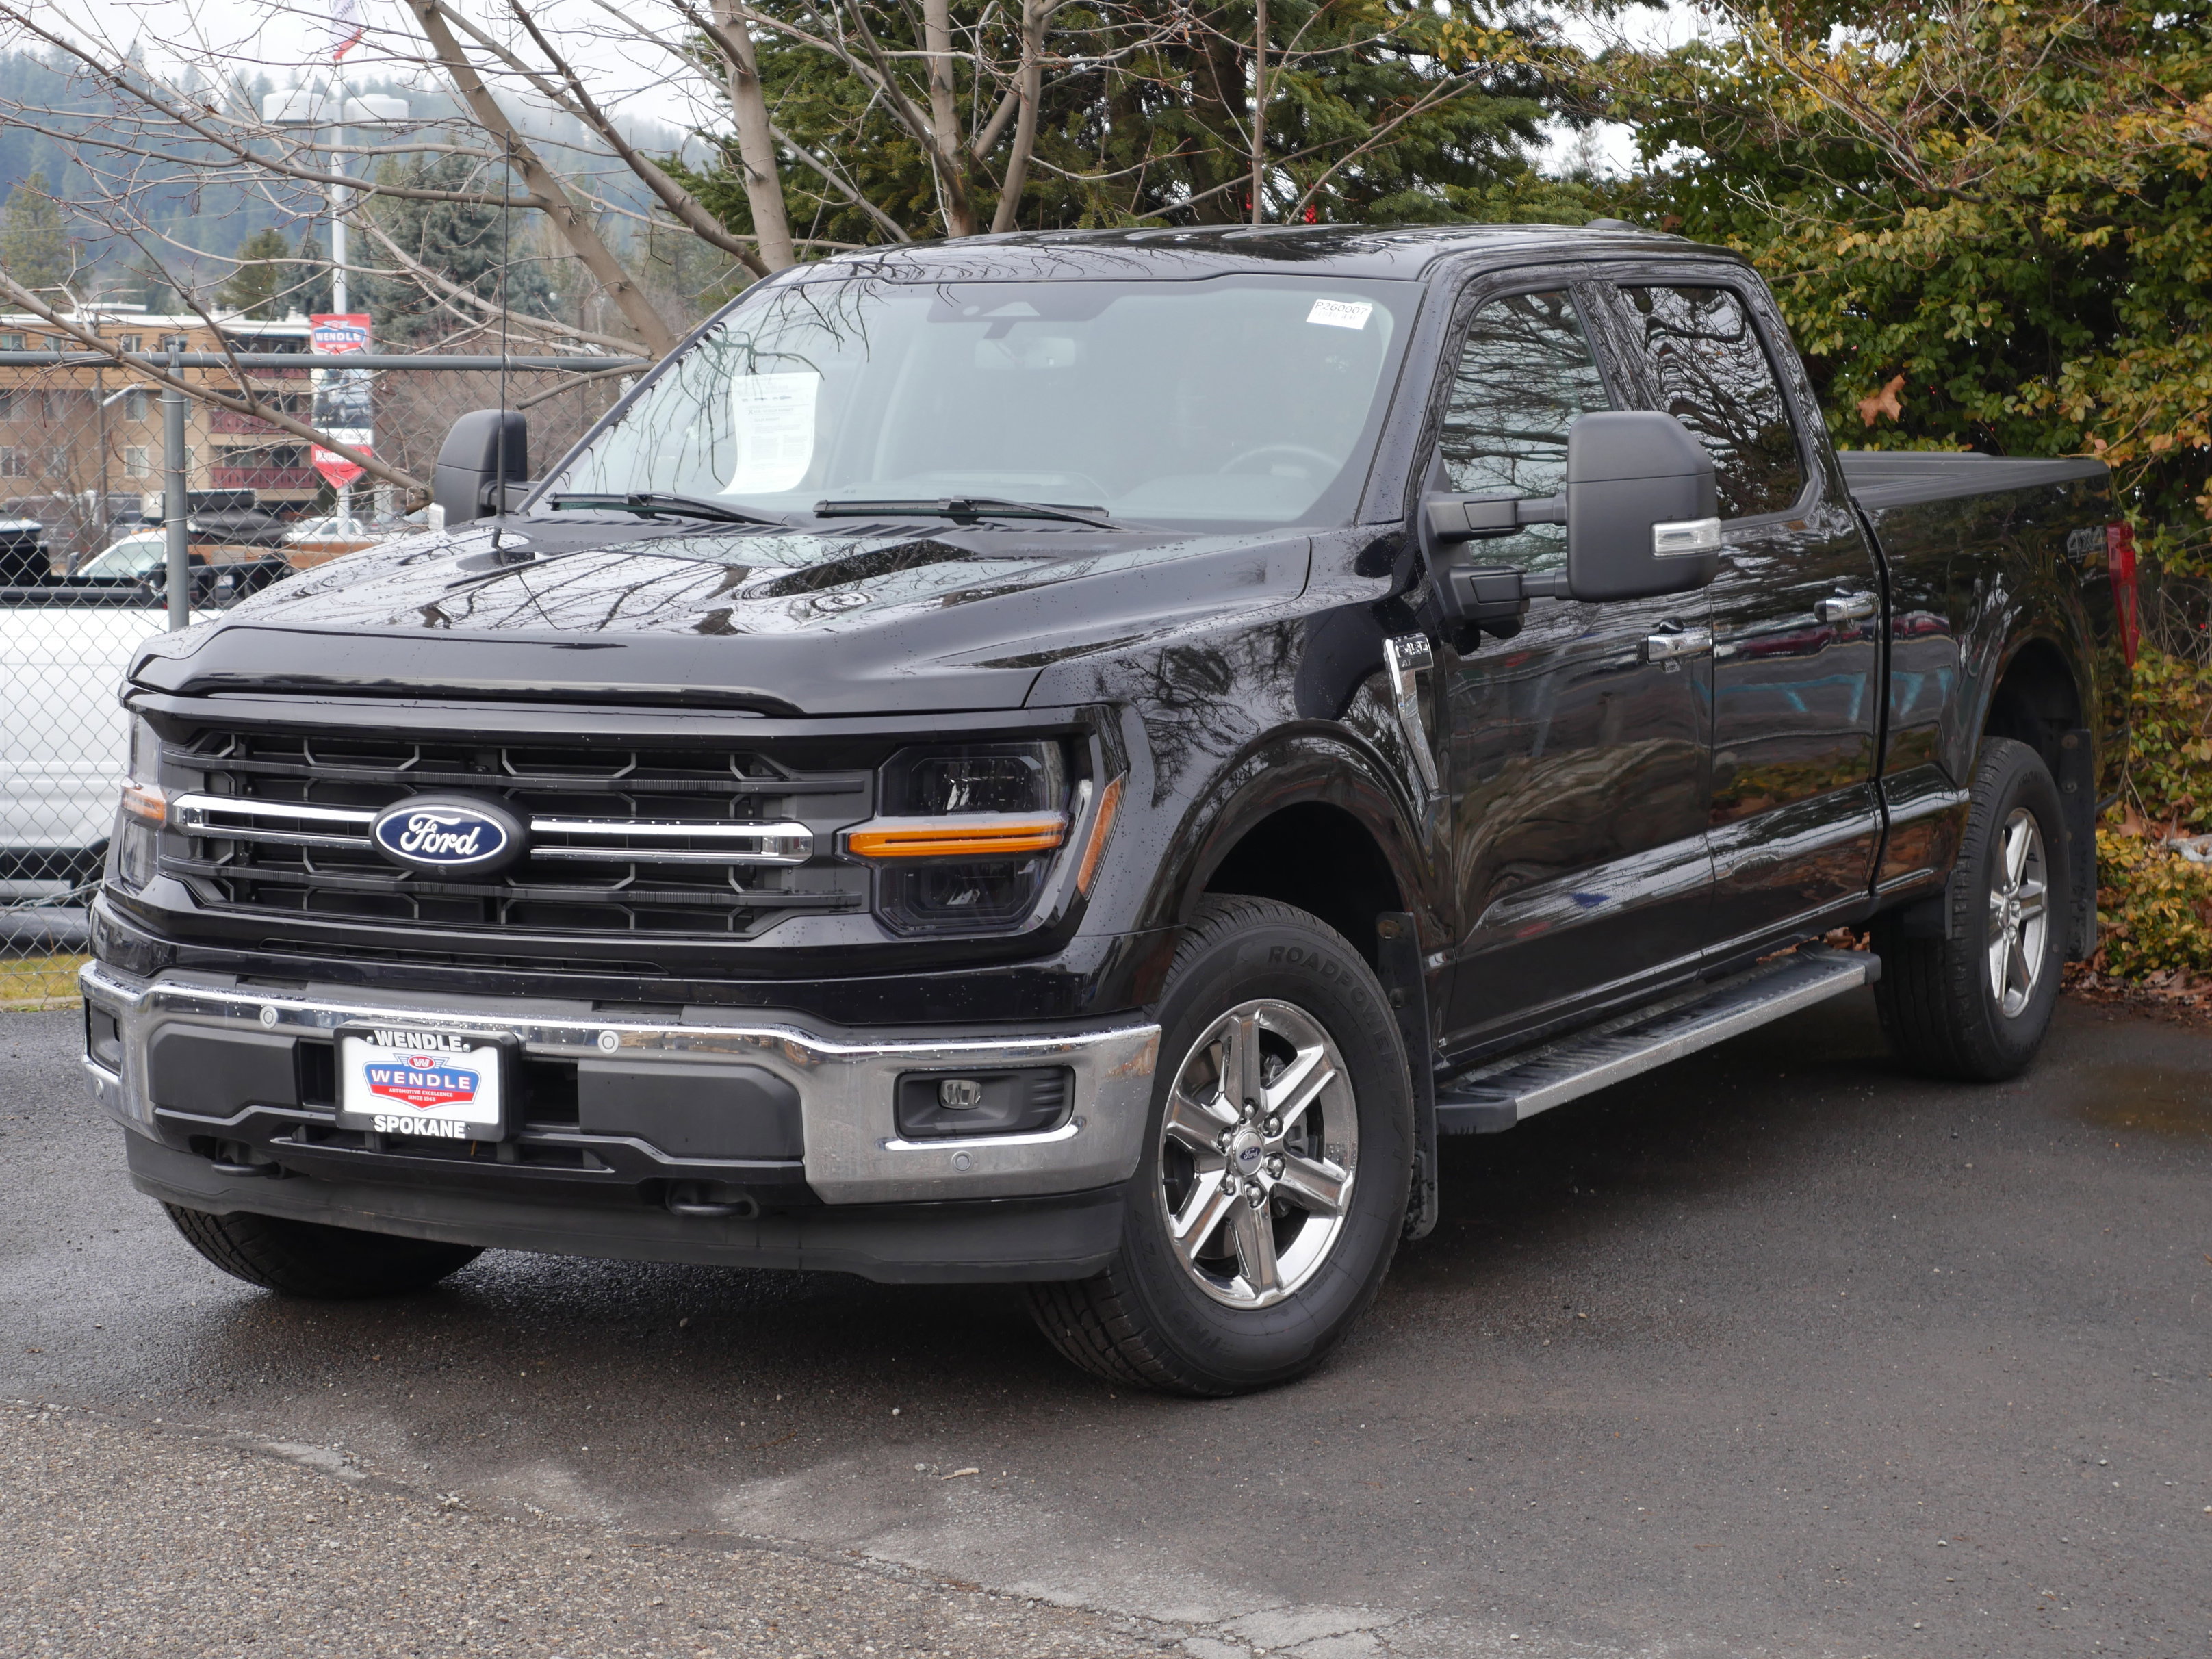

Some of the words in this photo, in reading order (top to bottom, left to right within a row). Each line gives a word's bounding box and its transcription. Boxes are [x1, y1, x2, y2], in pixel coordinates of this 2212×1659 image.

[1315, 301, 1368, 316] P260007
[316, 332, 361, 341] WENDLE
[400, 813, 482, 855] Ford
[374, 1030, 463, 1052] WENDLE
[413, 1057, 430, 1067] W
[370, 1069, 470, 1090] WENDLE
[374, 1115, 465, 1139] SPOKANE
[1243, 1148, 1259, 1159] Ford
